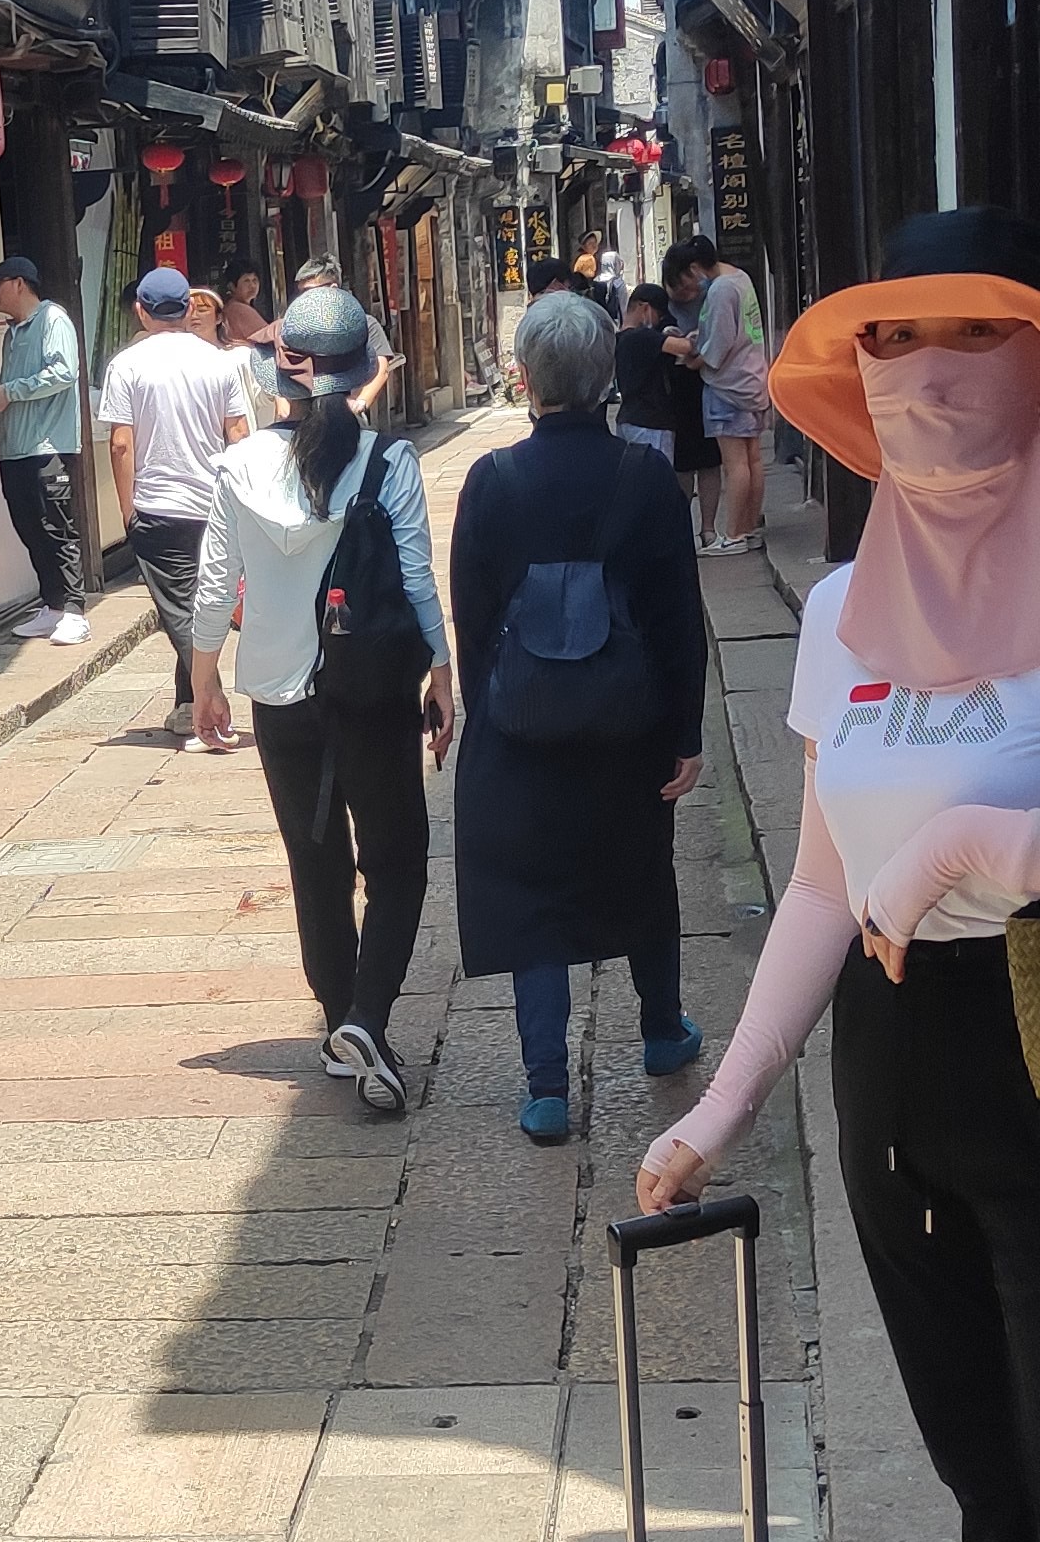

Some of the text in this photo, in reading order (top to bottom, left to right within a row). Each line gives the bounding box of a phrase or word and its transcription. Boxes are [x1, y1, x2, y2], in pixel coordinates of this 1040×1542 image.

[717, 133, 751, 231] 名檀阁别院
[154, 232, 176, 267] 祖
[833, 680, 1008, 748] FILA
